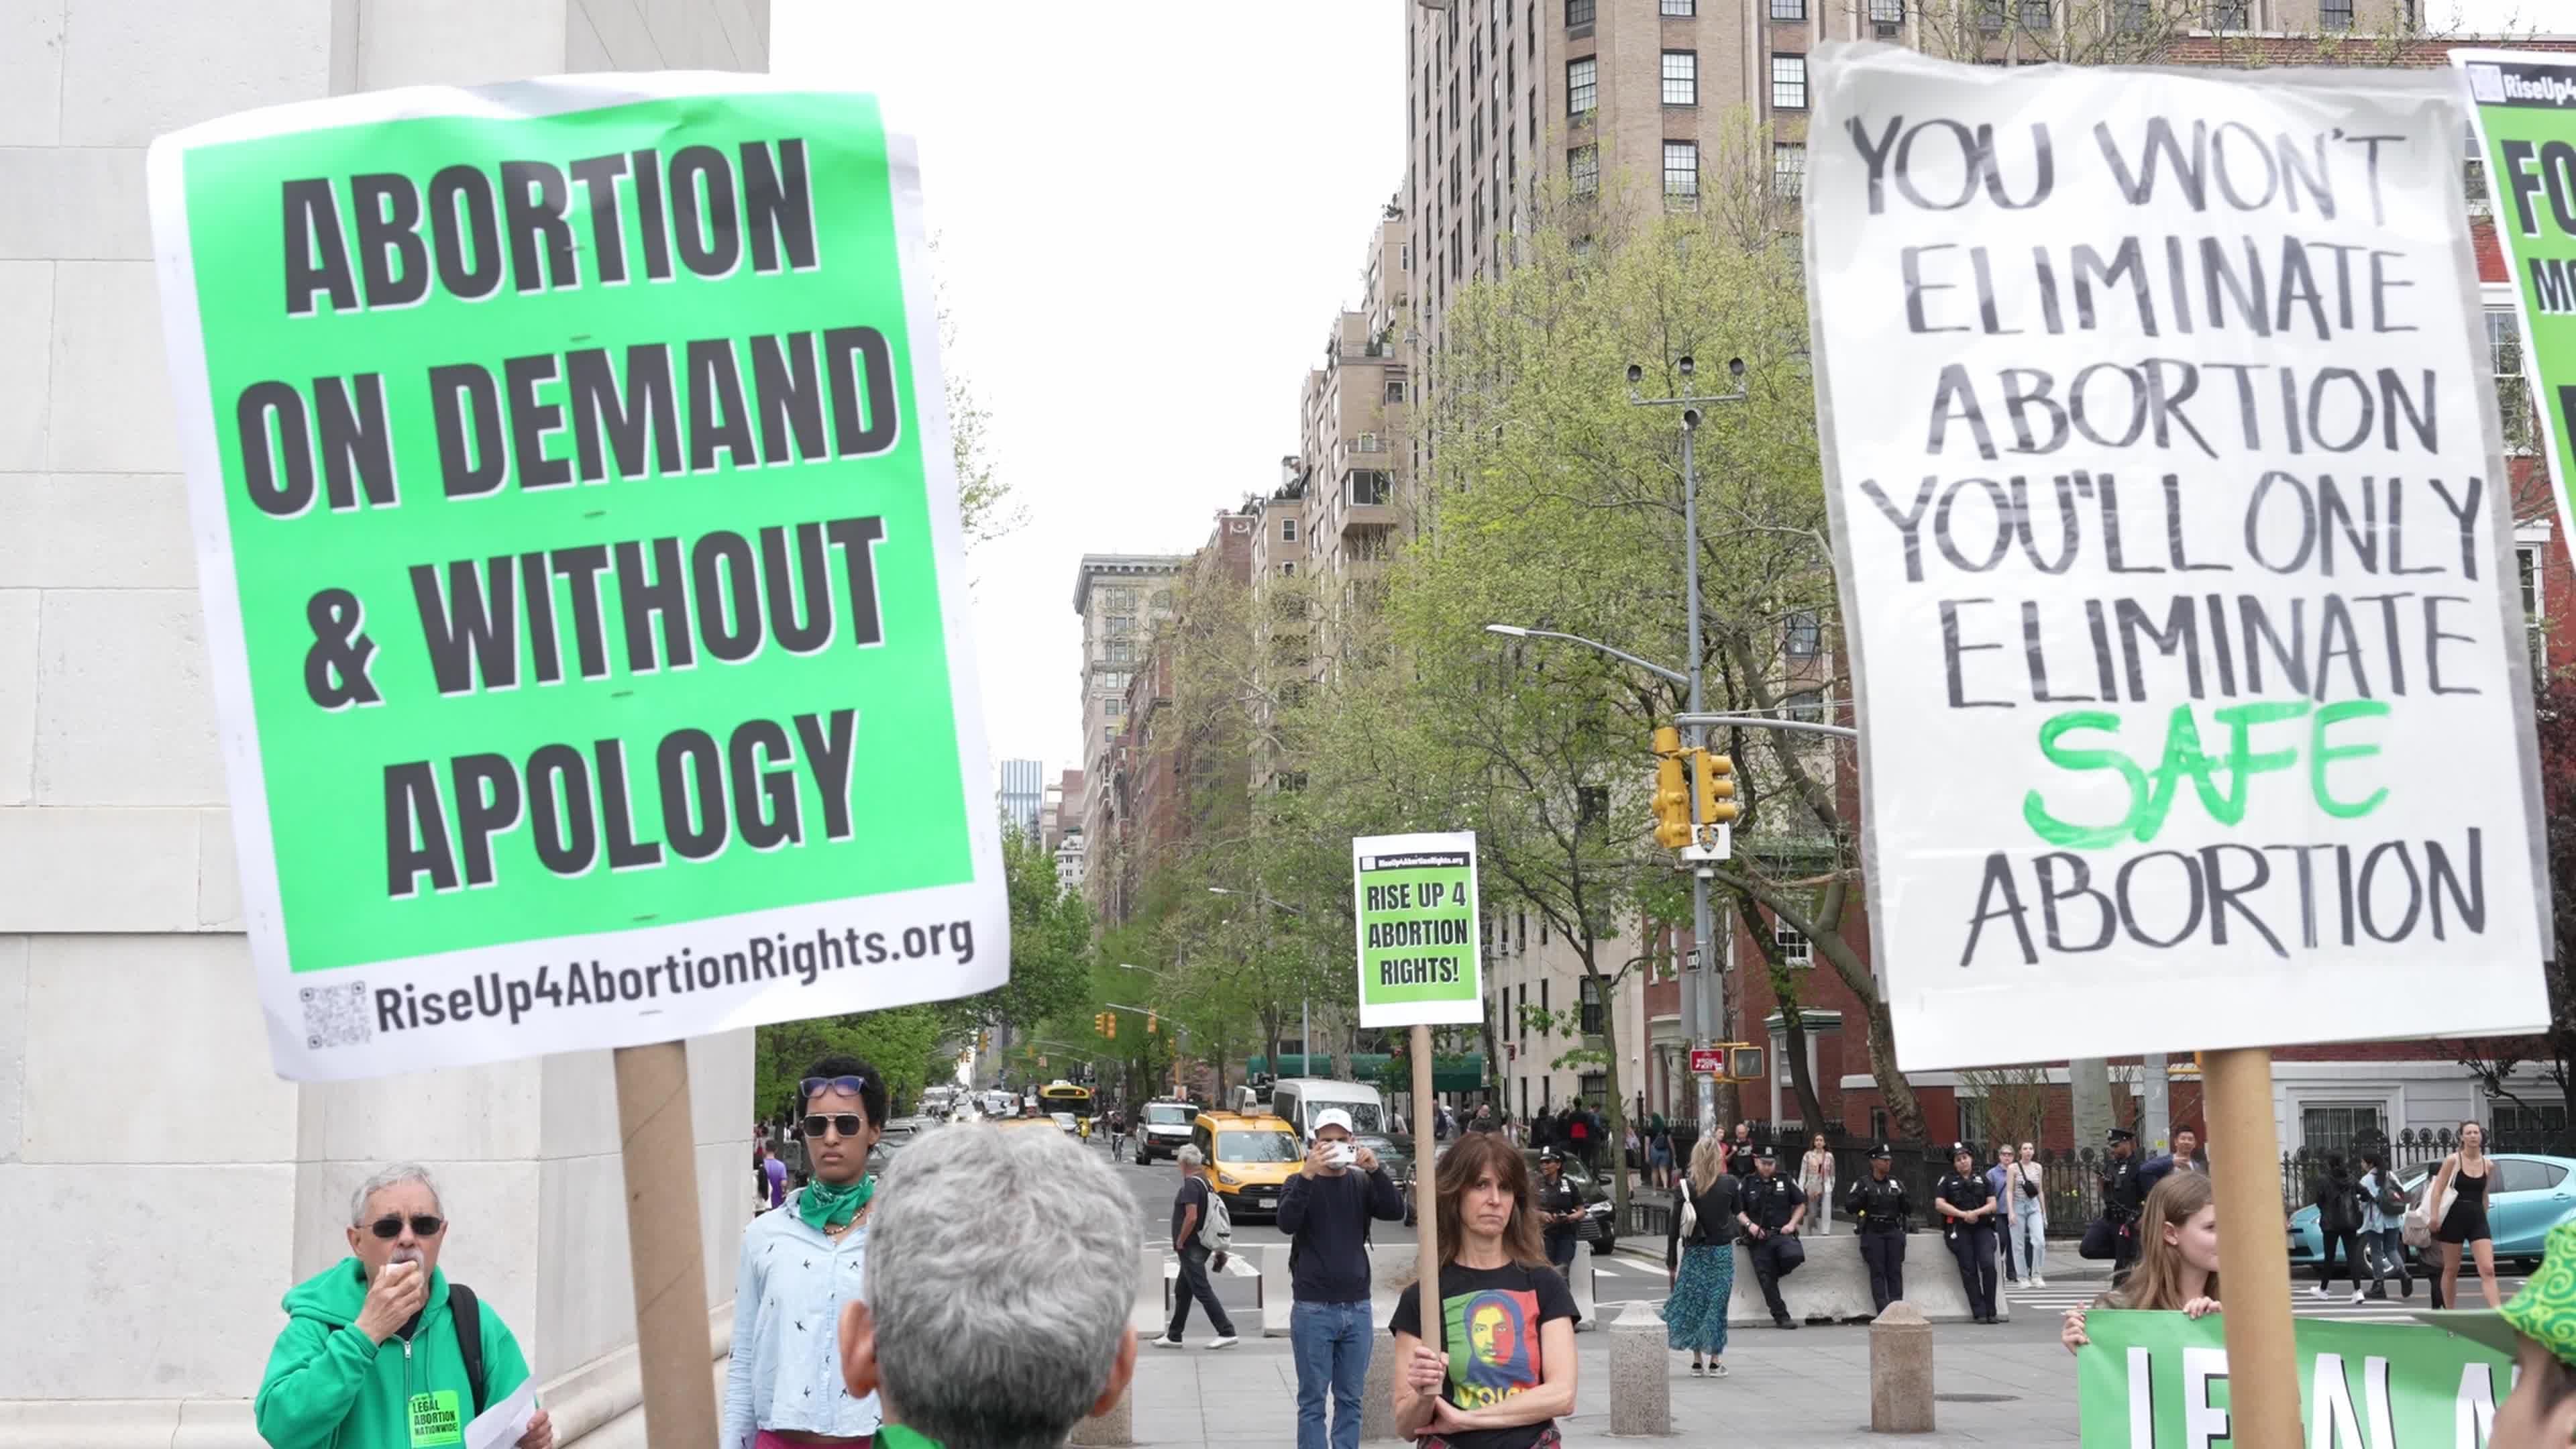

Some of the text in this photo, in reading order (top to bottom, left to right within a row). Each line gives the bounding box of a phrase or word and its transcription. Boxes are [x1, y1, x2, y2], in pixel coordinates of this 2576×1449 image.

[282, 138, 815, 313] ABORTION
[1844, 115, 2407, 225] YOU WON'T
[1900, 235, 2418, 341] ELIMINATE
[237, 326, 897, 515] ON DEMAND
[1925, 358, 2439, 461] ABORTION
[1860, 470, 2483, 582] YOU'LL ONLY
[304, 515, 883, 708] & WITHOUT
[1939, 592, 2483, 708] ELIMINATE
[384, 708, 855, 896] APOLOGY
[2023, 698, 2392, 849] SAFE
[1367, 881, 1466, 911] RISE UP 4
[1368, 919, 1468, 948] ABORTION
[1960, 826, 2486, 967] ABORTION
[375, 921, 975, 1032] RiseUp4AbortionRights.org
[1380, 957, 1460, 985] RIGHTS!
[413, 1399, 440, 1413] LEGAL
[415, 1411, 455, 1426] ABORTION
